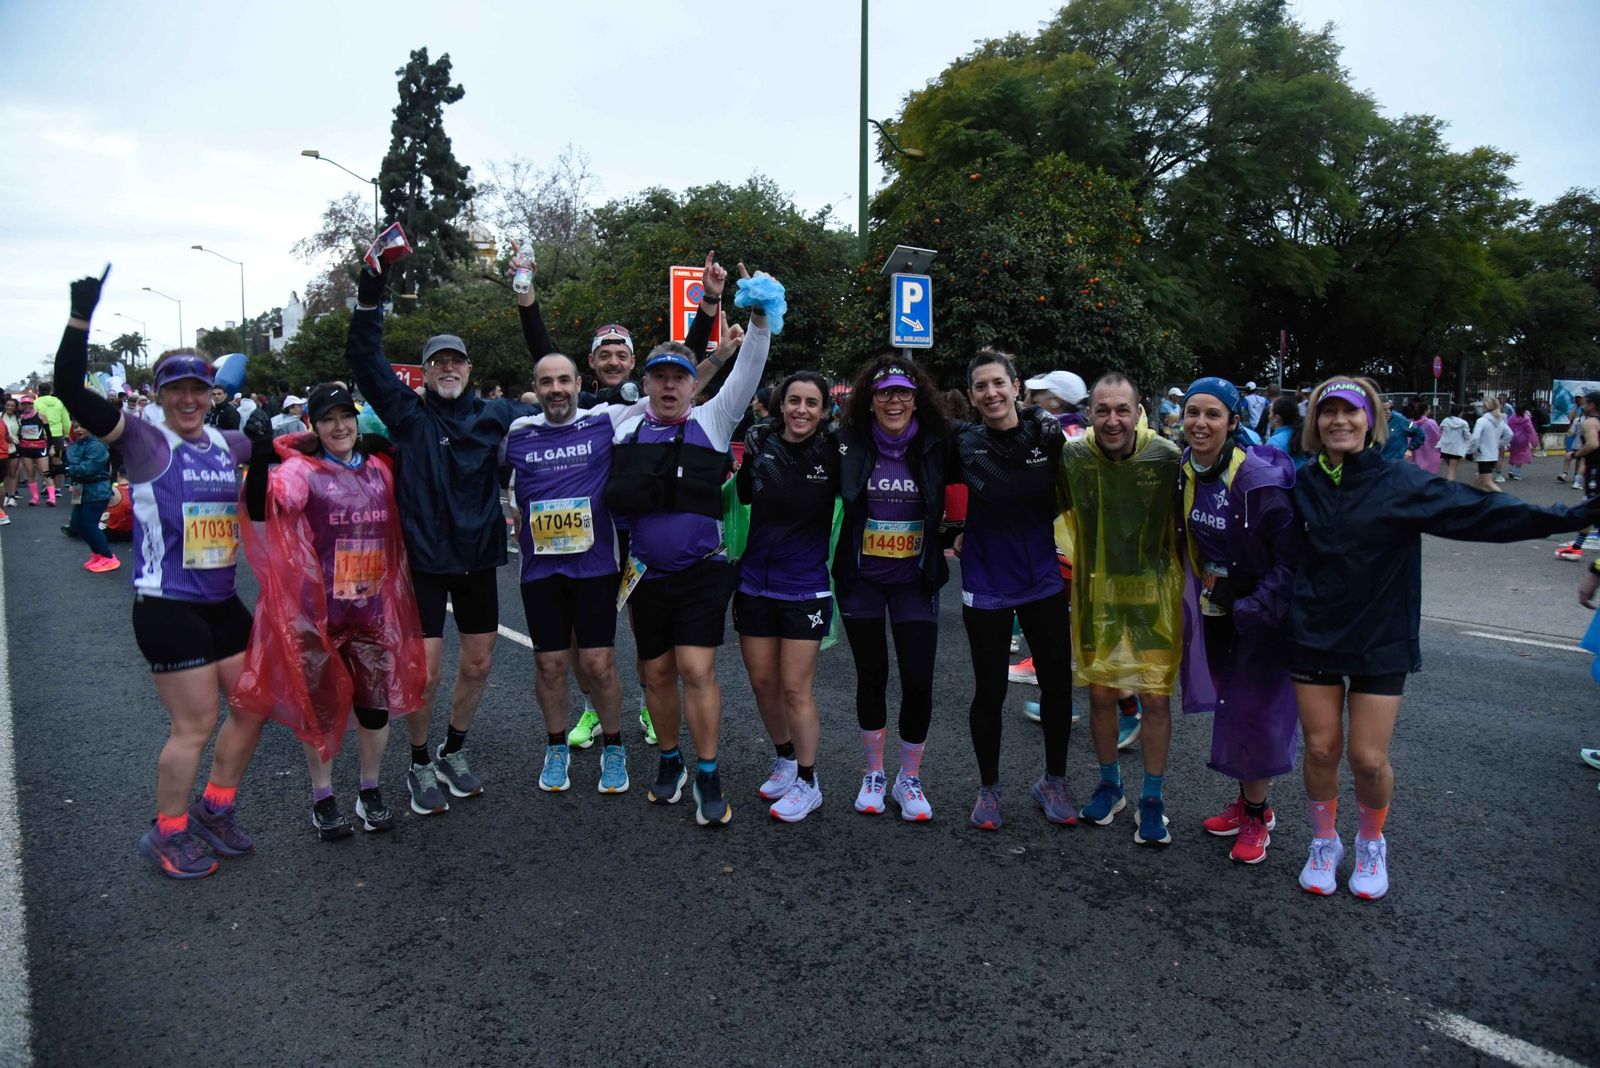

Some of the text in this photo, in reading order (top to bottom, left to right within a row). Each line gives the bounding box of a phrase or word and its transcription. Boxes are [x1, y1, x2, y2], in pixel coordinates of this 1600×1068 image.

[902, 281, 924, 314] P
[525, 451, 543, 463] EL
[543, 440, 592, 460] GARBÍ
[182, 469, 200, 482] EL
[867, 477, 919, 493] L GAR
[328, 509, 389, 526] EL GARB
[535, 512, 583, 532] 17045
[1191, 508, 1227, 530] GARB
[191, 519, 233, 540] 17033
[868, 533, 914, 552] 14498
